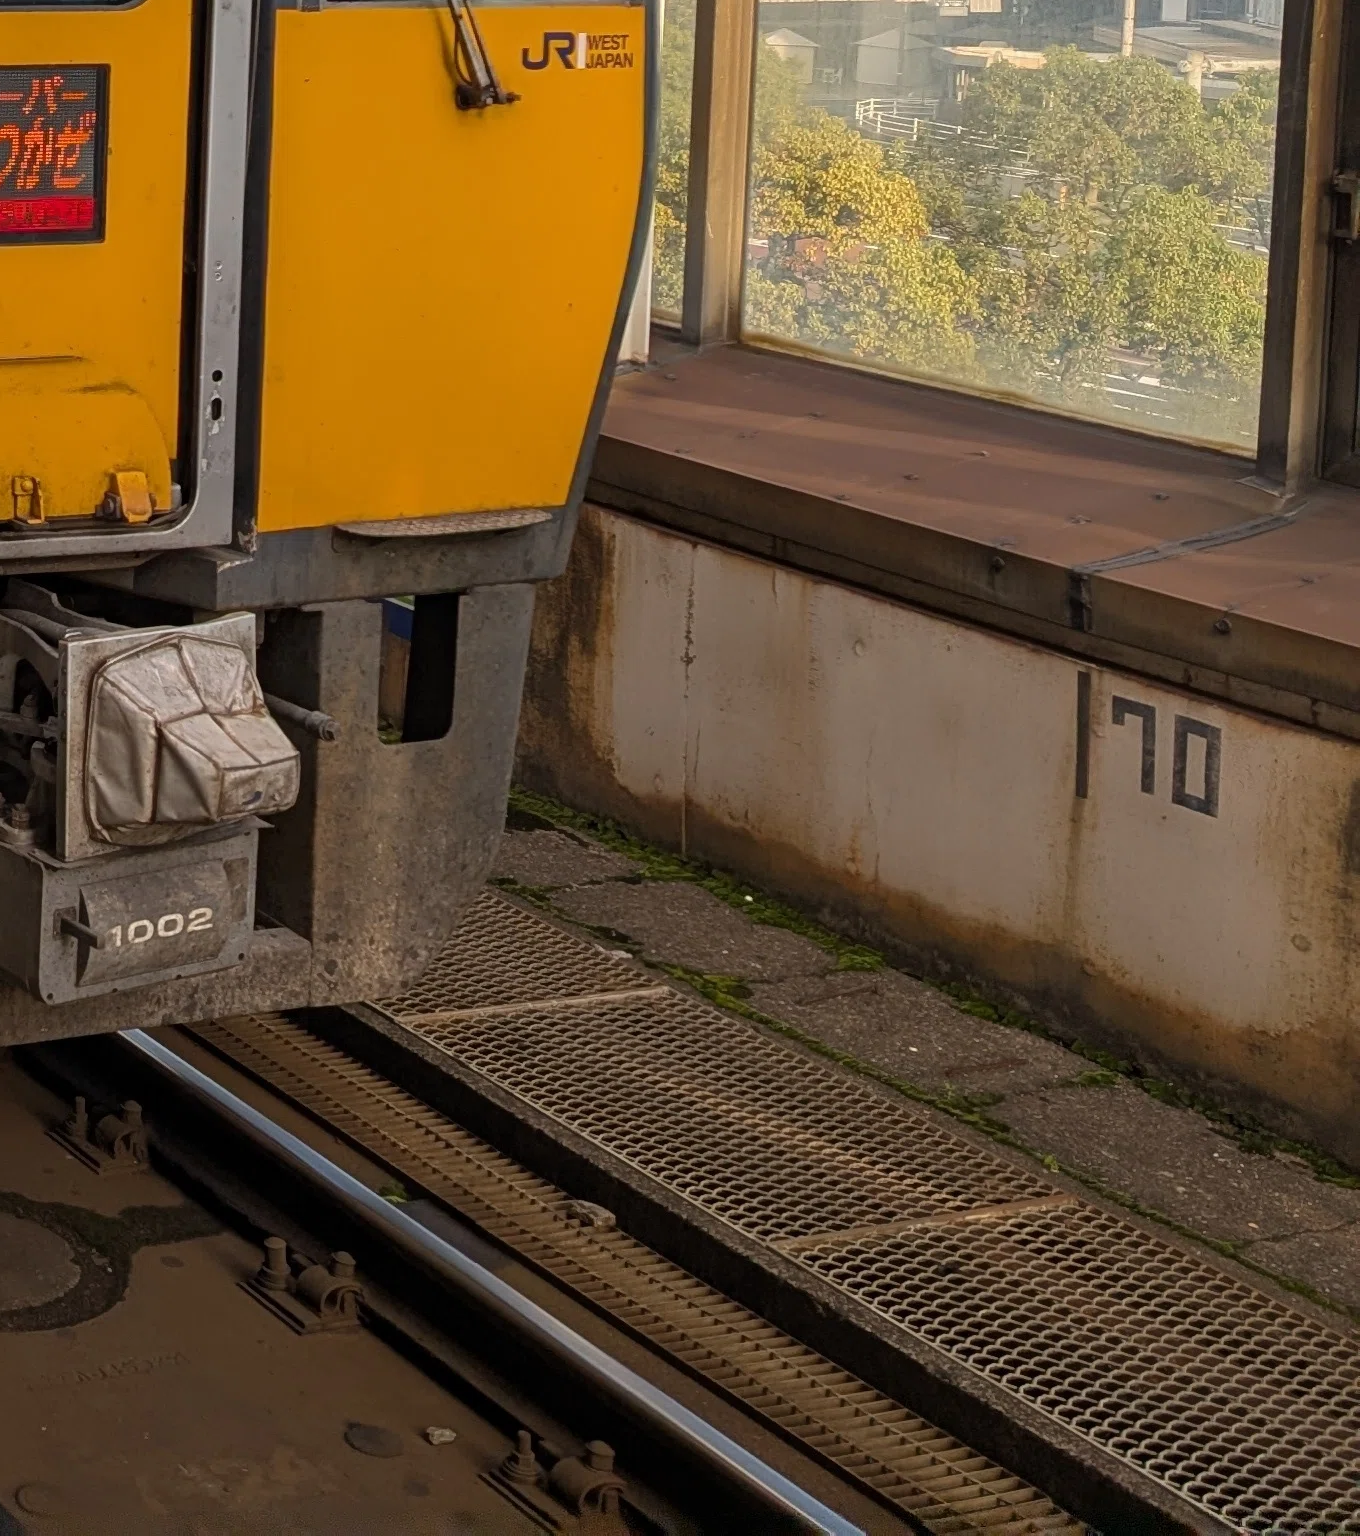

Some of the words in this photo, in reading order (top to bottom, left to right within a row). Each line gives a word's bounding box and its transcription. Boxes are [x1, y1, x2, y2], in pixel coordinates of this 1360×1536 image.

[522, 31, 576, 70] JR
[586, 34, 630, 51] WEST
[586, 52, 634, 69] JAPAN
[1111, 694, 1223, 819] 70
[107, 906, 214, 948] 1002
